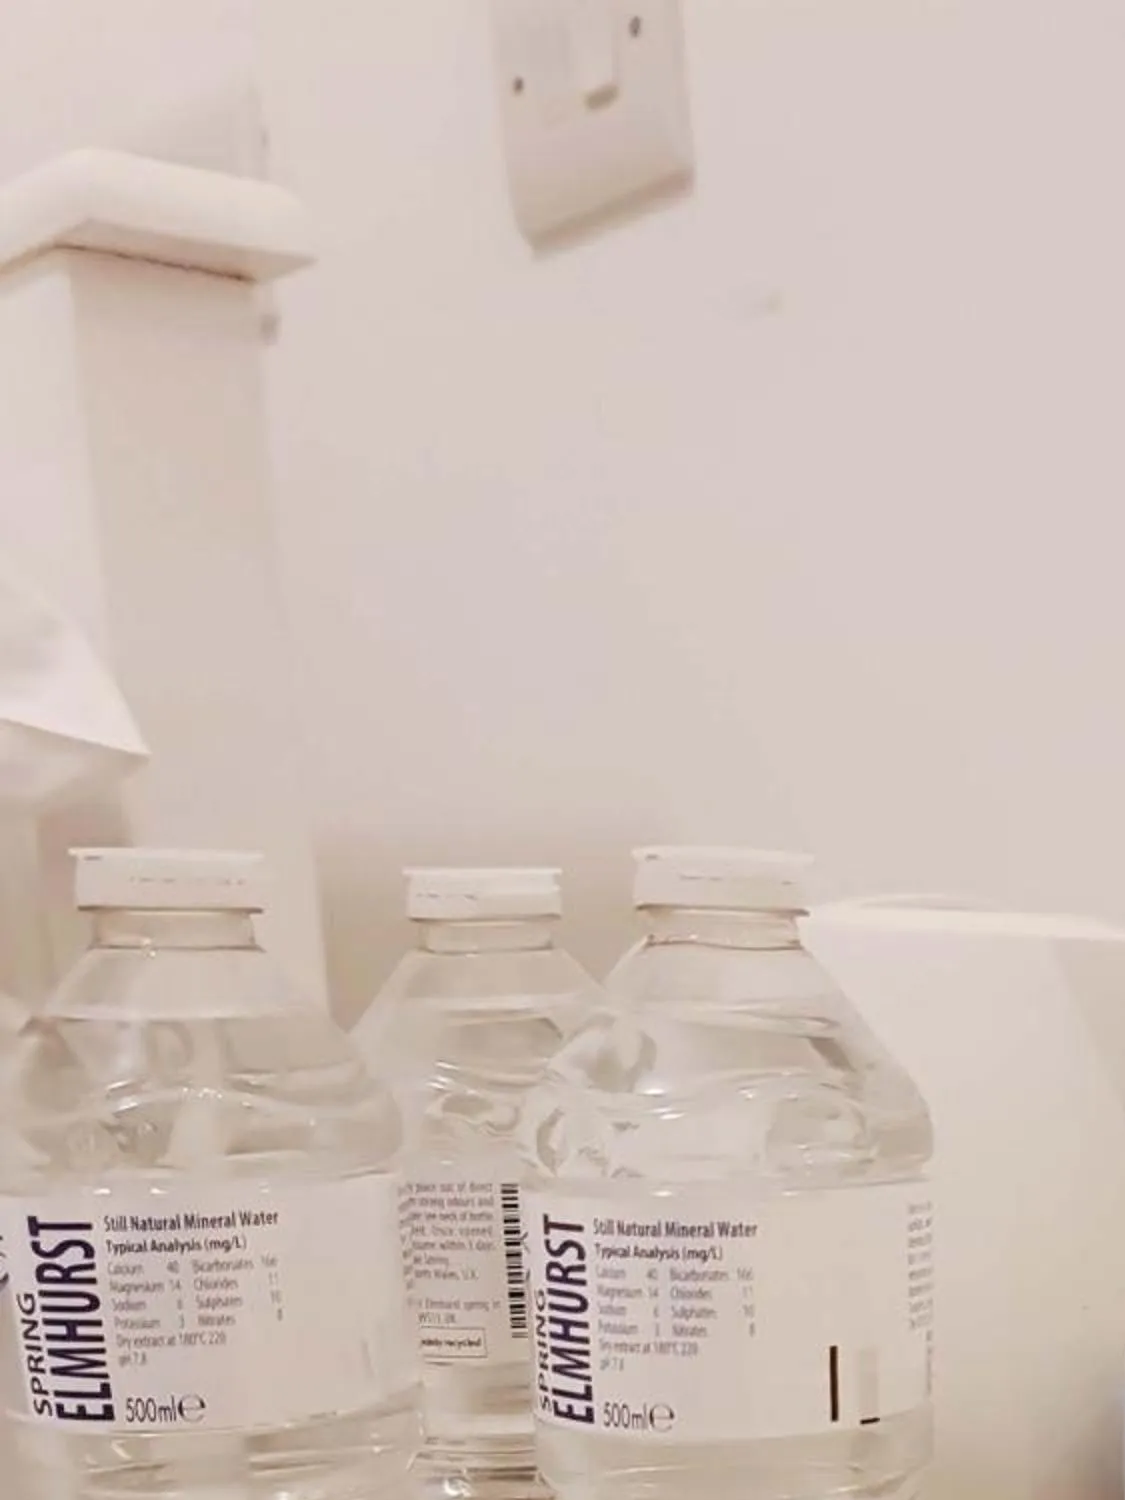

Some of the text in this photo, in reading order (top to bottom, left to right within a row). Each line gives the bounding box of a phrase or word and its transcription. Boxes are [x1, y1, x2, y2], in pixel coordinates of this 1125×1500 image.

[104, 1210, 279, 1232] Still Natural Mineral Water
[105, 1239, 147, 1256] Typical
[150, 1237, 203, 1254] Analysis
[593, 1218, 758, 1238] Still Natural Mineral Water
[594, 1243, 631, 1260] Typical
[633, 1245, 680, 1261] Analysis
[16, 1292, 53, 1416] SPRING
[27, 1215, 115, 1422] ELMHURST
[535, 1289, 551, 1411] SPRING
[543, 1213, 595, 1424] ELMHURST
